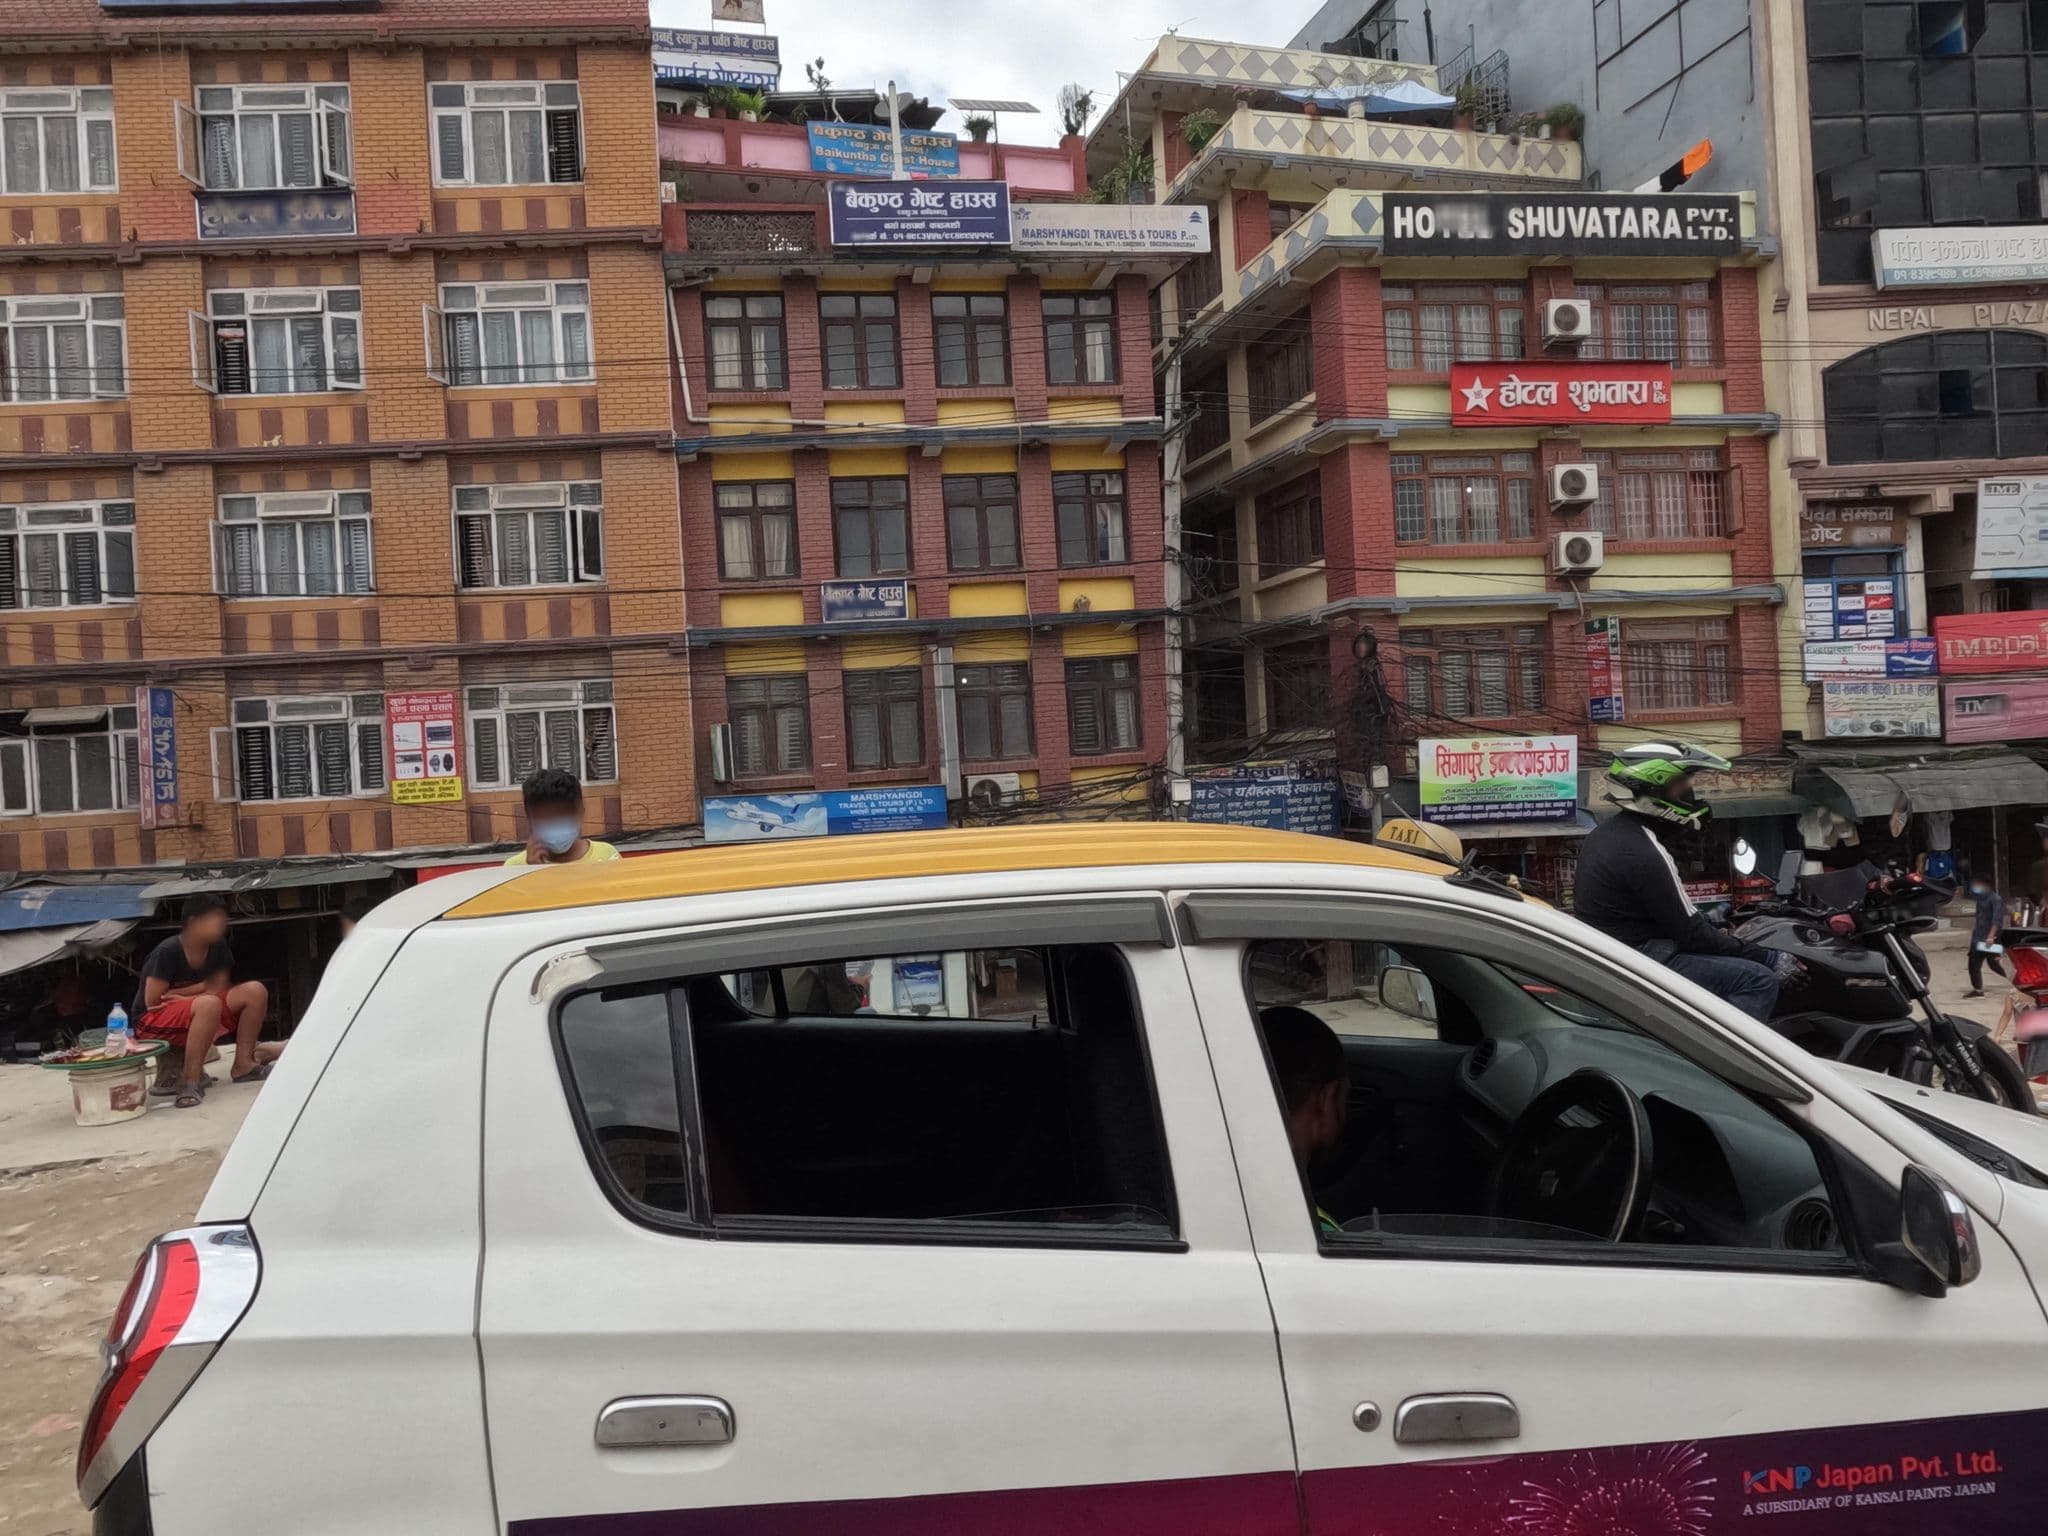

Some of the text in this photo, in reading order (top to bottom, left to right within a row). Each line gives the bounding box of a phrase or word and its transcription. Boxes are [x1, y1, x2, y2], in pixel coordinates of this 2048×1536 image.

[910, 135, 953, 148] हाउस
[815, 145, 877, 162] Baikuntha
[880, 154, 915, 165] Gust
[918, 156, 956, 168] House
[910, 187, 945, 208] गेष्ट
[950, 192, 997, 209] हाउस
[1507, 206, 1683, 239] SHUVATARA
[1686, 207, 1734, 223] PVT.
[1021, 228, 1090, 240] MARSHYANGDI
[1094, 229, 1137, 240] TRAVEL'S
[1139, 231, 1145, 240] &
[1147, 230, 1178, 241] TOURS
[1686, 225, 1735, 241] LTD.
[1868, 307, 1944, 331] NEPAL
[1499, 374, 1649, 413] होटल शुभतारा
[1810, 523, 1844, 543] गेष्ट
[878, 586, 903, 601] हाउस
[1806, 645, 1854, 655] Evergreen
[1856, 643, 1882, 652] Tours
[850, 791, 923, 802] MARSHYANGDI
[879, 799, 904, 807] TOURS
[1390, 826, 1419, 845] TAXI
[1743, 1450, 2003, 1494] KNP Japan Pvt. Ltd.
[1743, 1482, 1996, 1516] A SUBSIDIARY OF KANSAI PAINTS JAPAN
